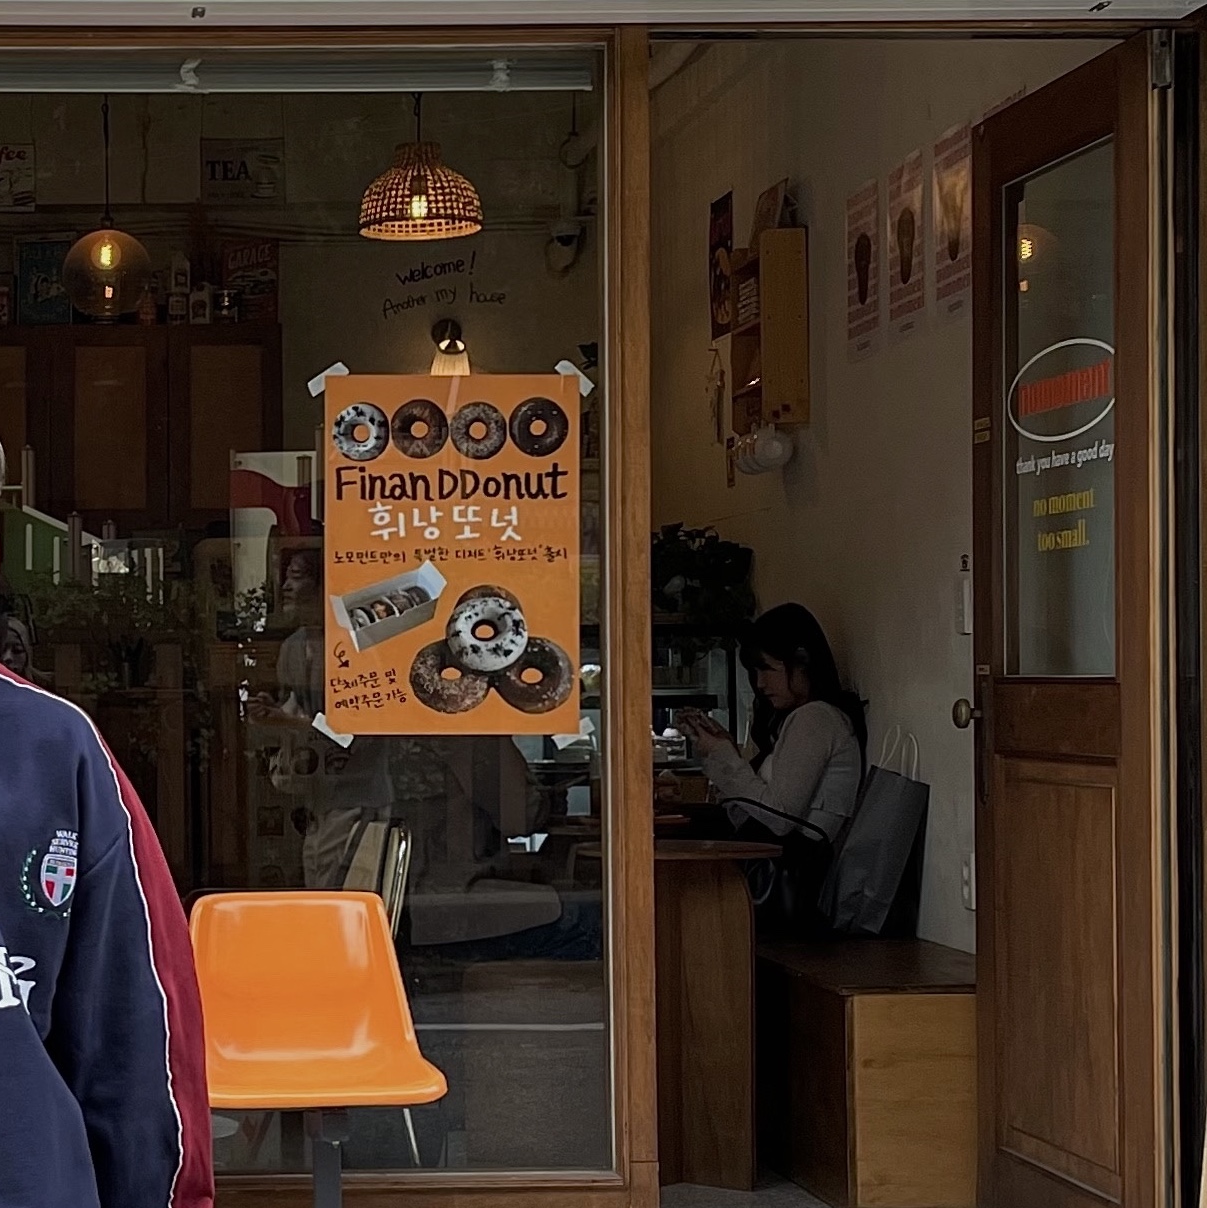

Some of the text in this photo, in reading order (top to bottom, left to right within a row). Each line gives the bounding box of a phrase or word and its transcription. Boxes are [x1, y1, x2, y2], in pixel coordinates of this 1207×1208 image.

[206, 160, 252, 182] TEA
[435, 286, 457, 305] my
[1016, 439, 1115, 476] thank you have a good day
[1032, 487, 1096, 517] no moment
[1037, 530, 1056, 551] too
